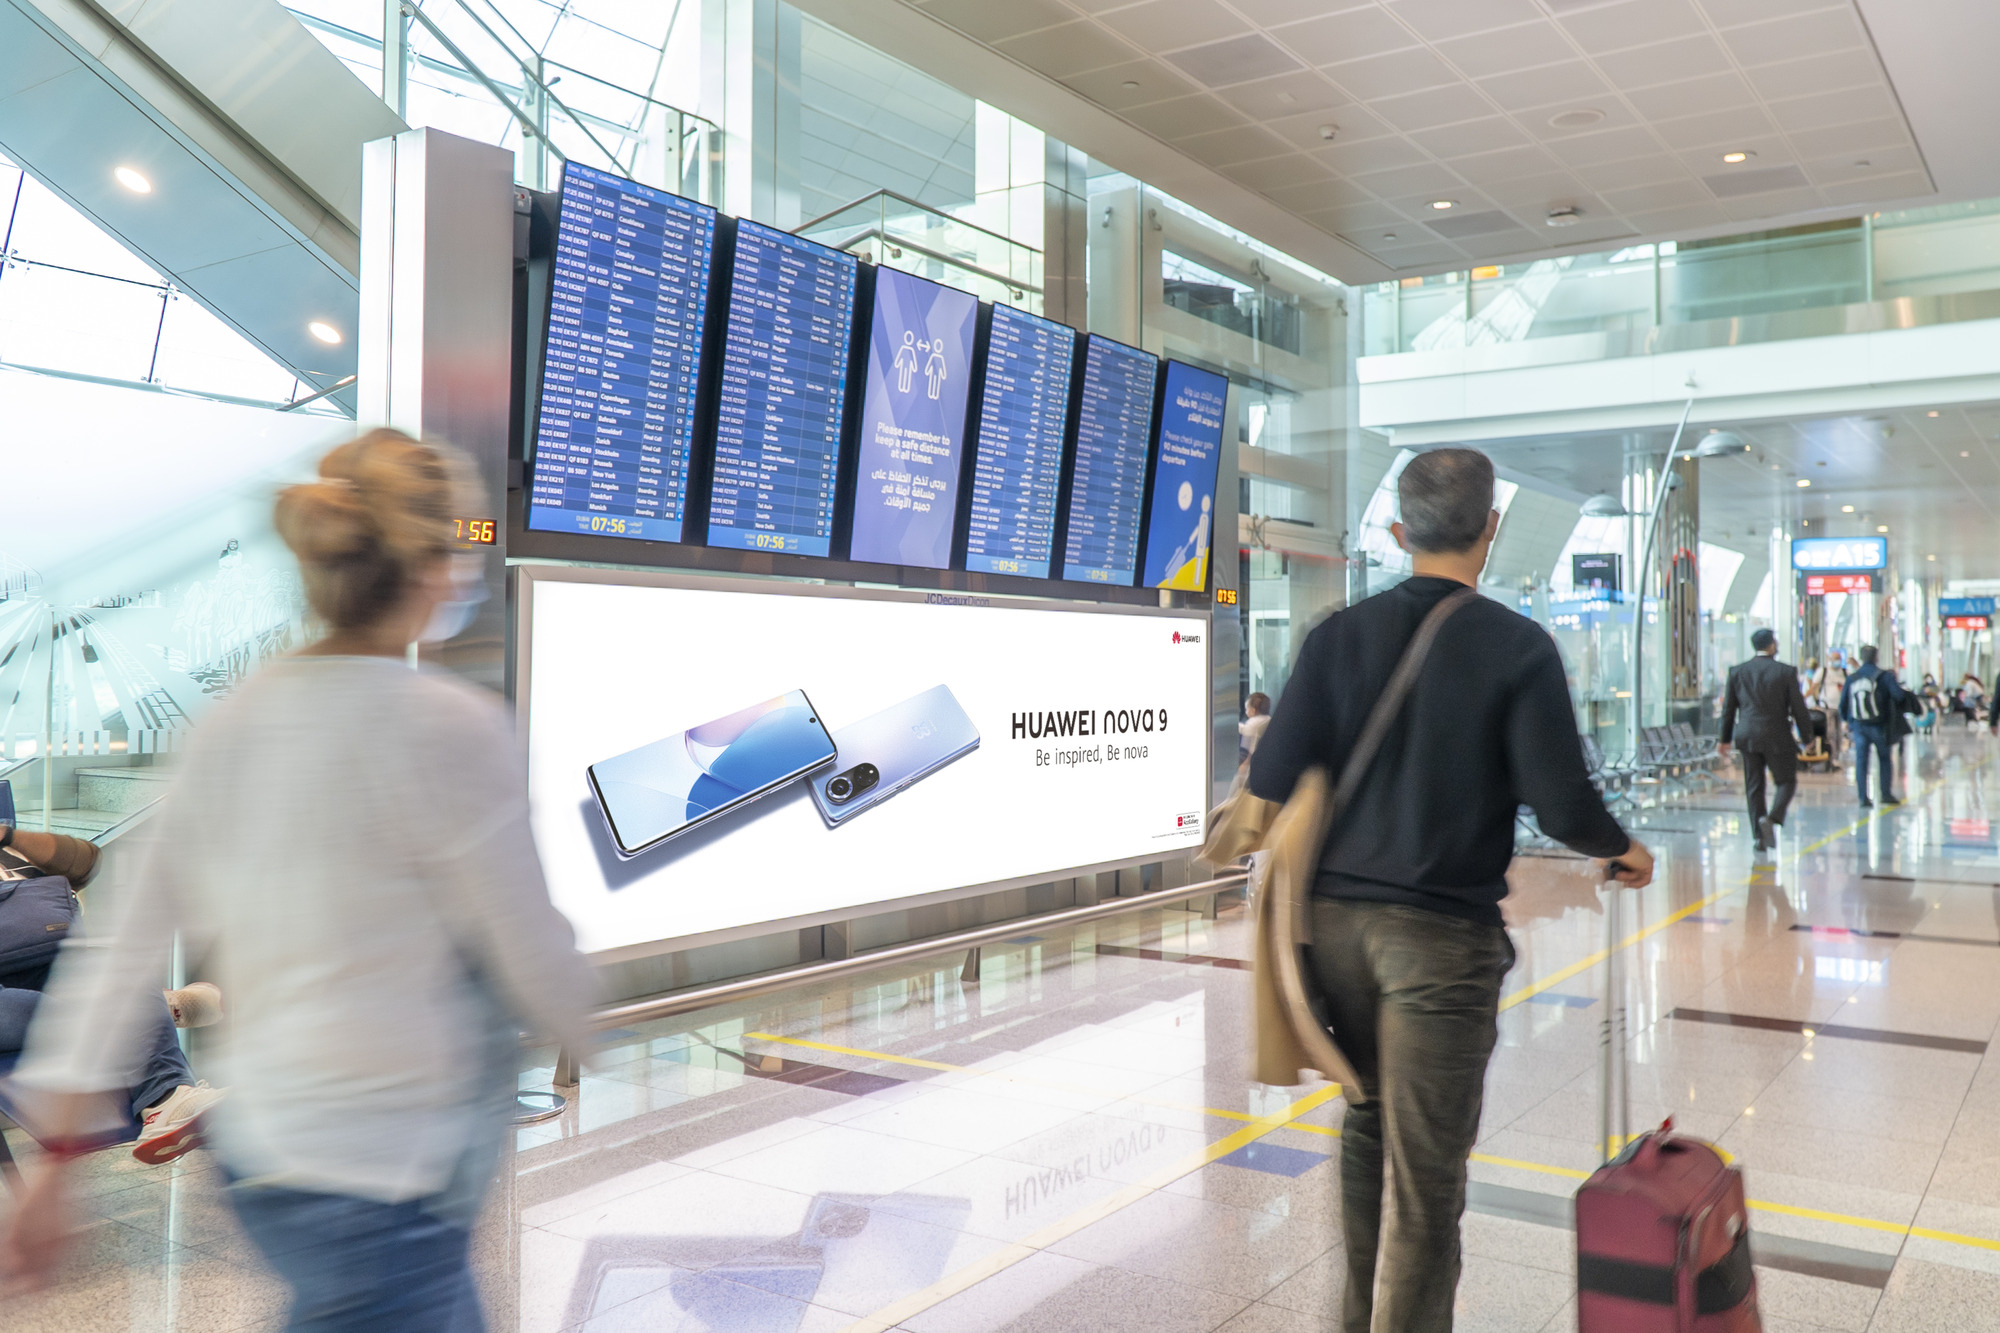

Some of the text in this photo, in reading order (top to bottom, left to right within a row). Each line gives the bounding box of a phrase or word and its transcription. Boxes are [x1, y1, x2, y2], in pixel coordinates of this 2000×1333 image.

[621, 193, 649, 208] Birmingham
[620, 204, 636, 214] Lisbon
[619, 215, 645, 229] Casablanca
[614, 260, 632, 270] London
[633, 265, 656, 277] Heathrow
[610, 305, 622, 313] Paris
[607, 327, 629, 338] Baghdad
[606, 338, 634, 349] Amsterdam
[605, 349, 625, 359] Toronto
[604, 360, 617, 368] Cairo
[603, 371, 620, 380] Boston
[602, 382, 613, 390] Nice
[600, 393, 630, 405] Copenhagen
[1190, 400, 1198, 410] 90
[599, 404, 613, 412] Kuala
[613, 407, 632, 416] Lumpur
[598, 415, 617, 424] Bahrain
[877, 421, 951, 446] Please remember to
[875, 433, 950, 456] keep a safe distance
[1165, 430, 1214, 450] Please check your gate
[595, 449, 620, 457] Stockholm
[890, 448, 934, 464] at all times.
[1163, 441, 1206, 459] 90 minutes before
[1162, 454, 1186, 466] departure
[871, 469, 947, 491] يرجى تذكر الحفاظ على
[600, 483, 620, 491] Angeles
[590, 492, 613, 500] Frankfurt
[911, 487, 936, 500] مسافة
[589, 503, 607, 511] Munich
[912, 501, 931, 513] جميع
[453, 519, 494, 542] 7:56
[591, 517, 626, 533] 07:56
[757, 534, 785, 550] 07:56
[1831, 543, 1881, 567] A15
[999, 560, 1018, 573] 07:56
[1091, 569, 1108, 581] 07:56
[1181, 635, 1201, 644] HUAWEI
[1011, 708, 1168, 740] HUAWEI nova 9
[1036, 744, 1149, 768] Be inspired, Be nova
